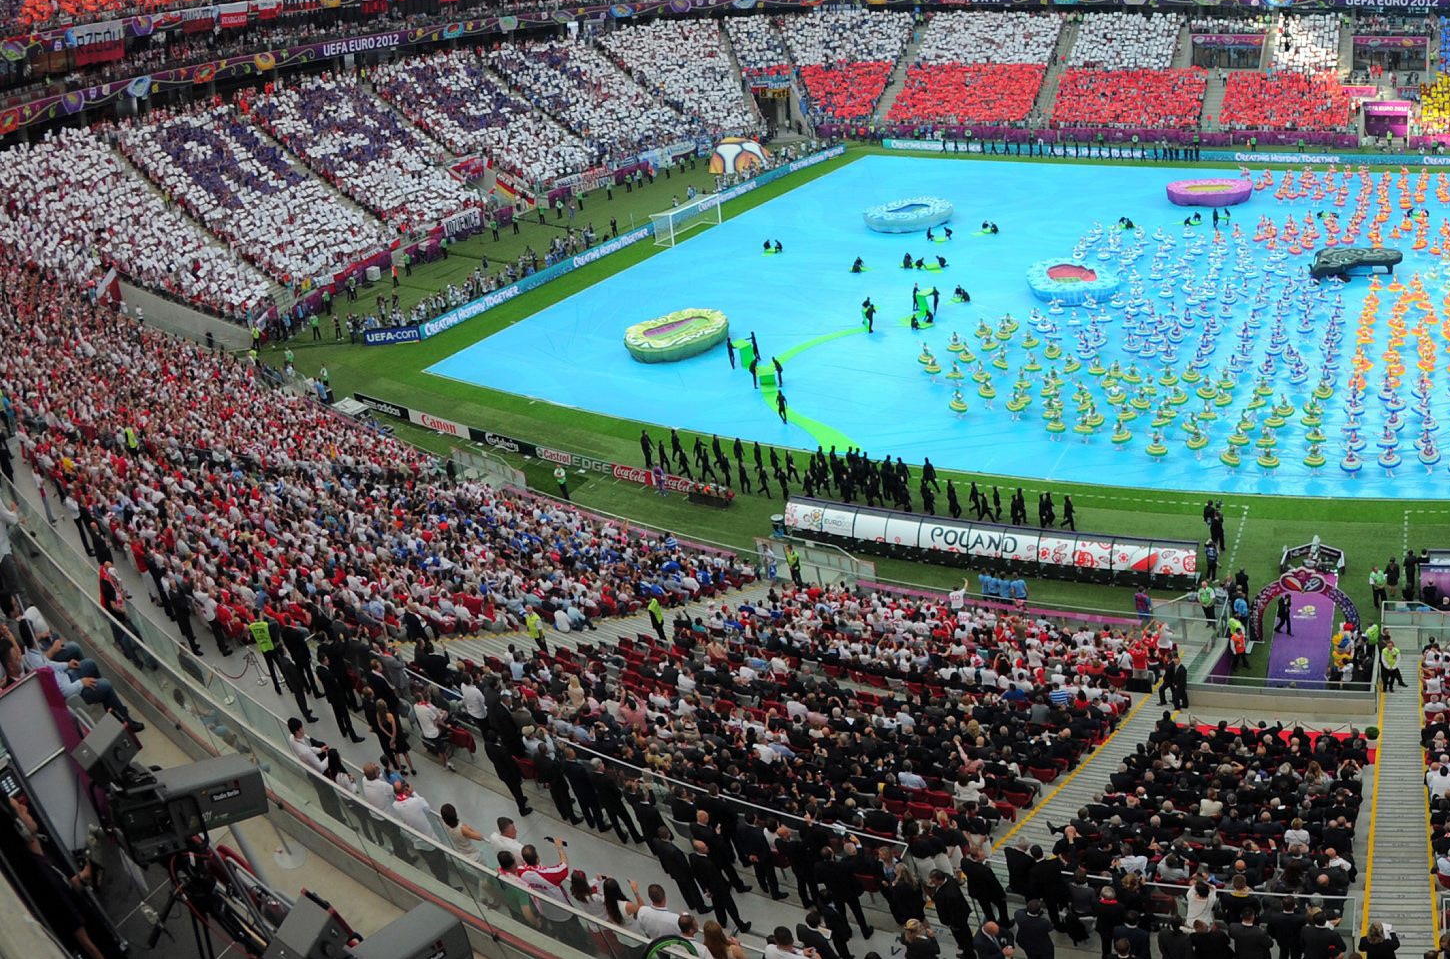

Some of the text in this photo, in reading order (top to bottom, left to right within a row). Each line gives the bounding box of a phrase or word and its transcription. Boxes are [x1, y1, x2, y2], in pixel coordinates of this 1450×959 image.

[323, 34, 399, 57] UEFA EURO 2012
[1235, 153, 1341, 163] CREATING HISTORY TOGETHER
[573, 228, 648, 268] CREATING HISTORY TOGETHER
[424, 285, 519, 336] CREATING HISTORY TOGETHER
[377, 403, 401, 417] adidas
[421, 414, 457, 434] Canon
[485, 432, 519, 452] Carlsberg
[544, 449, 612, 474] Castrol EDGE
[613, 465, 646, 483] Coca-Cola
[931, 527, 1018, 553] POLAND
[213, 793, 227, 802] Studio
